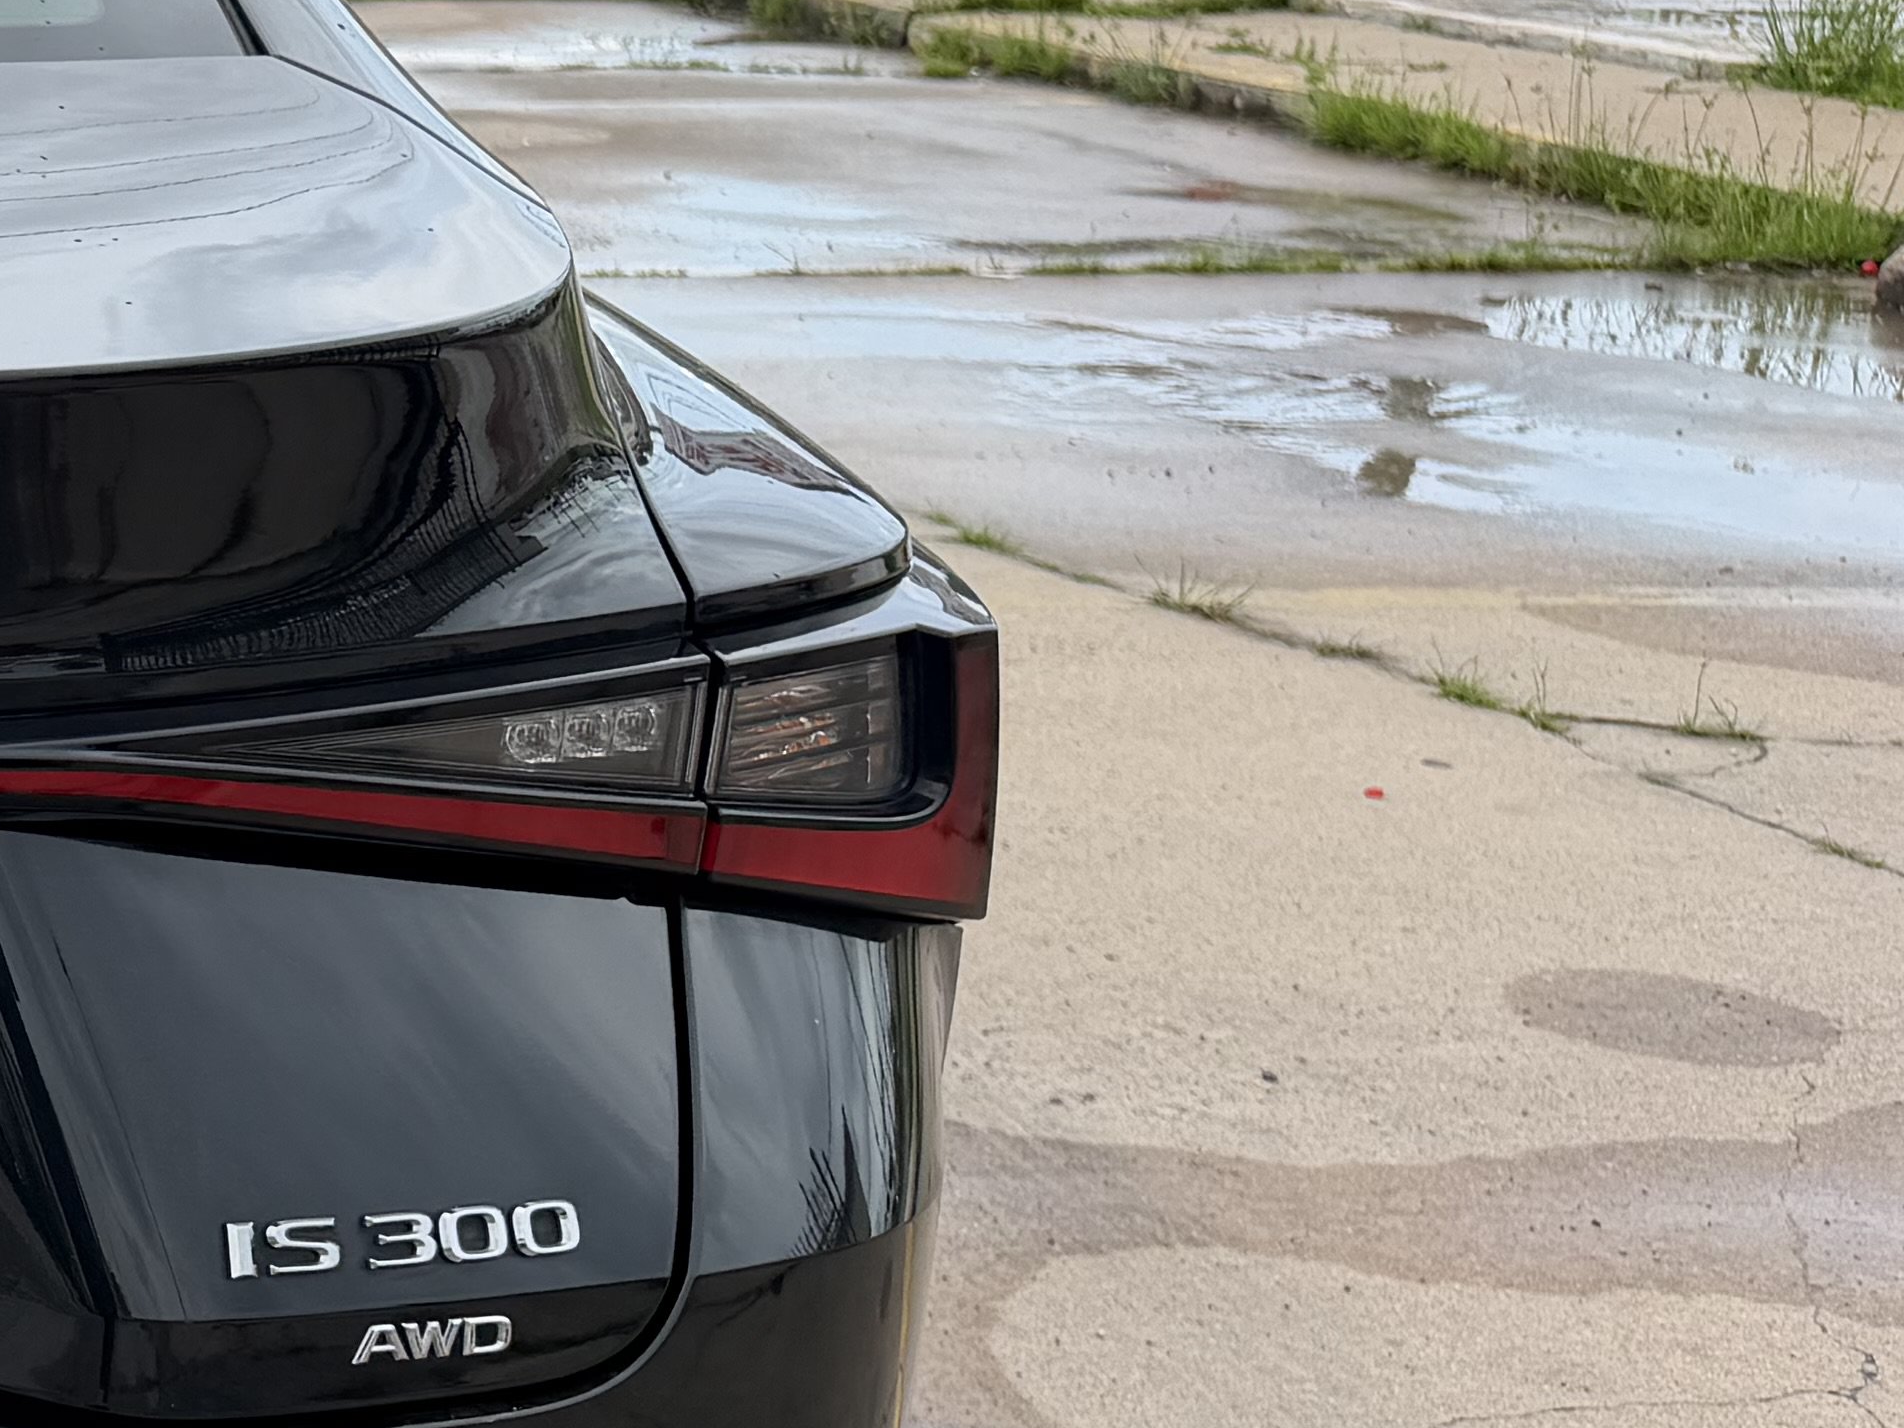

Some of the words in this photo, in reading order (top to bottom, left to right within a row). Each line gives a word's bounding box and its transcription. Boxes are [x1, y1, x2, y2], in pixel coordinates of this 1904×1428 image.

[226, 1217, 341, 1279] IS
[363, 1198, 581, 1270] 300
[351, 1314, 513, 1365] AWD
